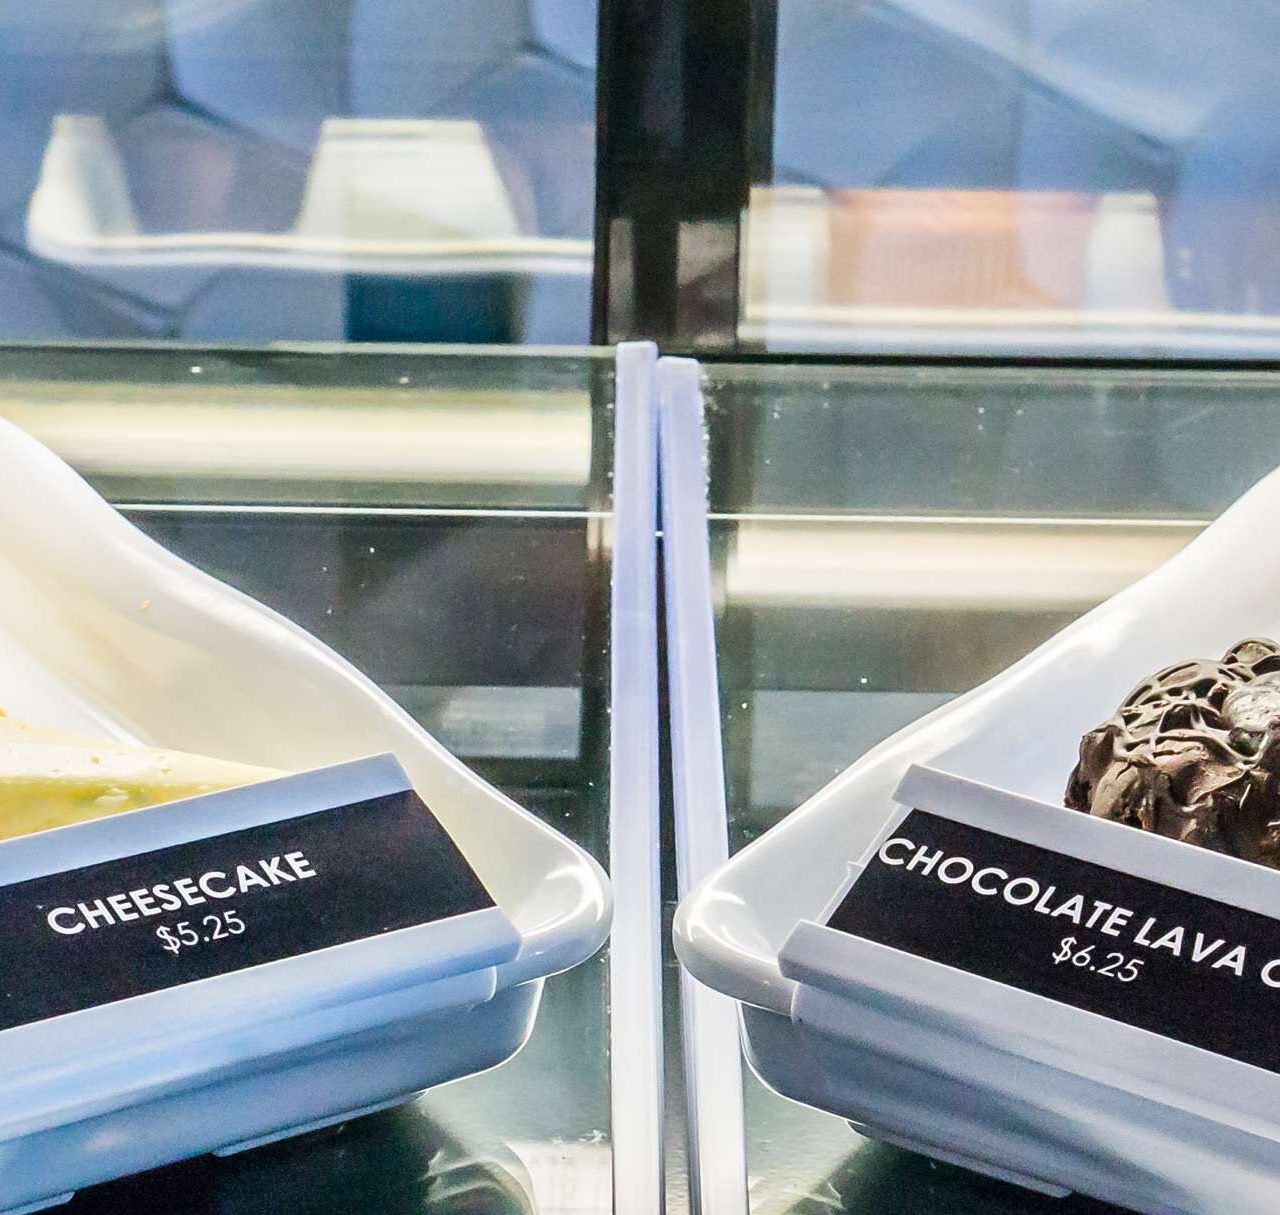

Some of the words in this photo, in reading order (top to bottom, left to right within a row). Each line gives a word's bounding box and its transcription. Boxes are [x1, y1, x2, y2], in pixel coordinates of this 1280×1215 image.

[46, 850, 318, 936] CHEESECAKE
[877, 836, 1135, 938] CHOCOLATE
[1132, 916, 1247, 977] LAVA
[154, 909, 247, 956] $5.25
[1051, 935, 1146, 983] $6.25
